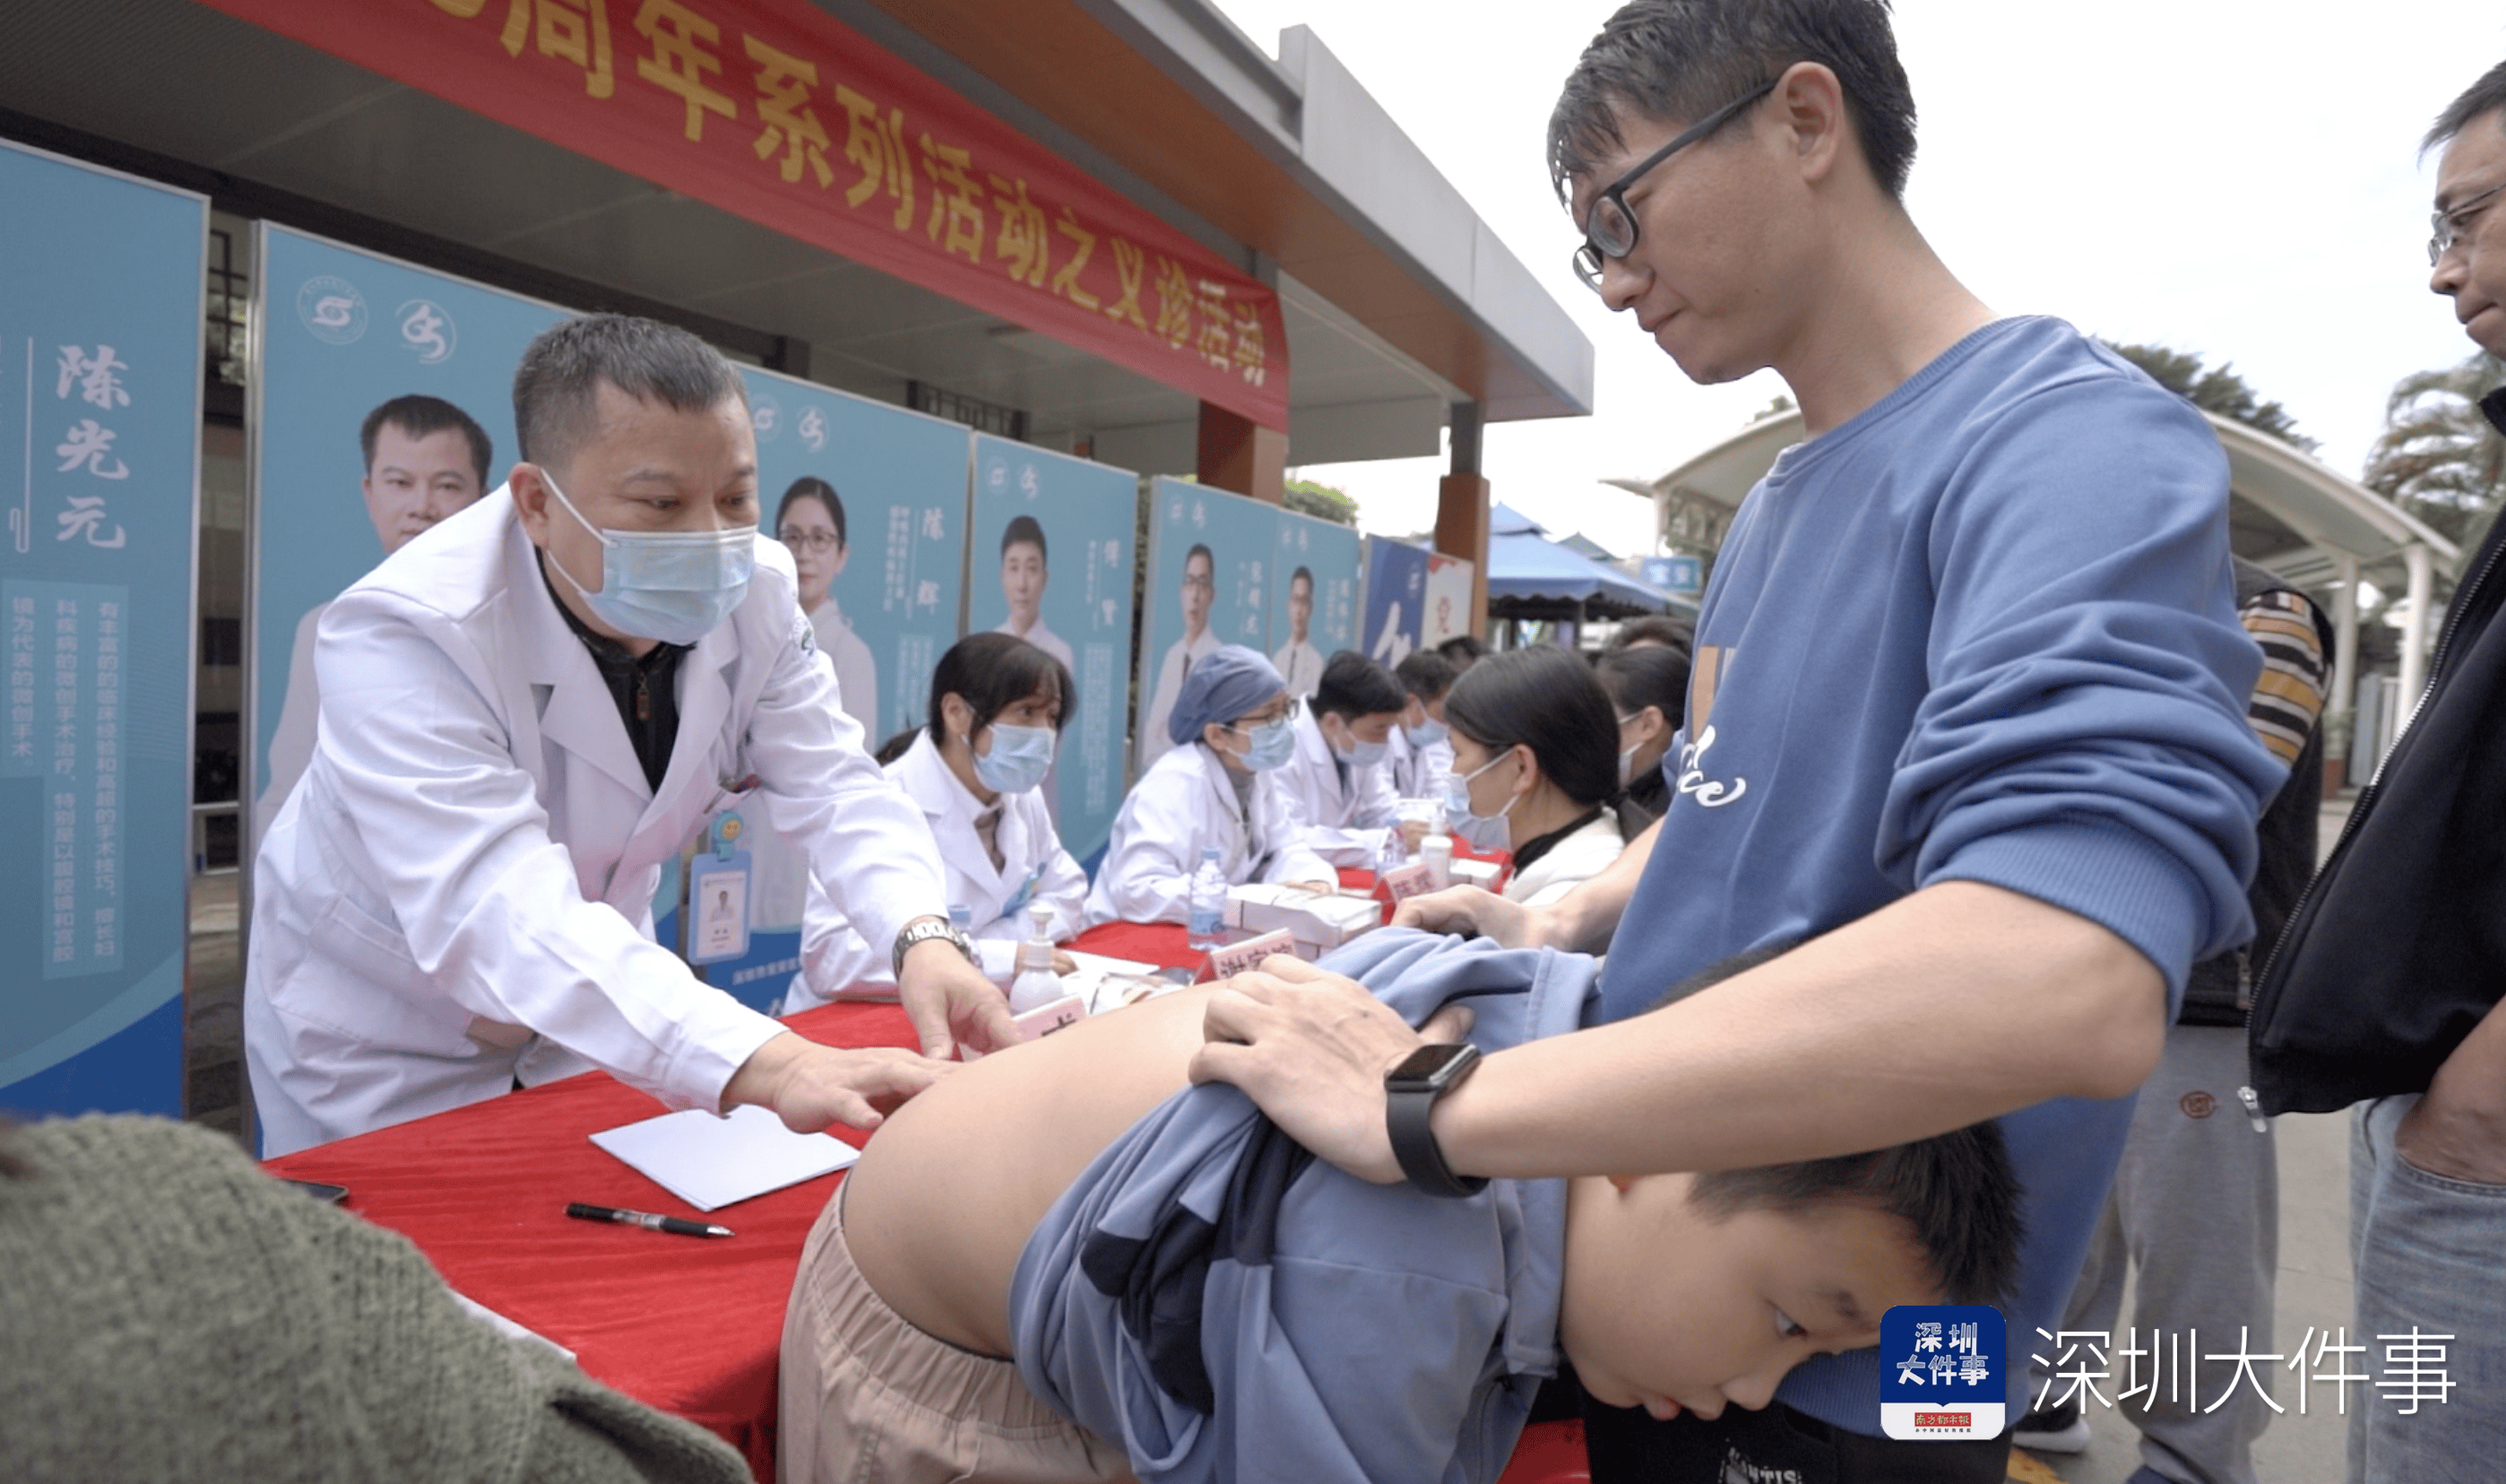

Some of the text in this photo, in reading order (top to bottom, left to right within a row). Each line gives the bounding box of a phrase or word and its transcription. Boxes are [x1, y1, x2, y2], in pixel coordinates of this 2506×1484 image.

[428, 0, 1266, 387] 周年系列活动之义诊活动
[56, 344, 132, 549] 陈光元
